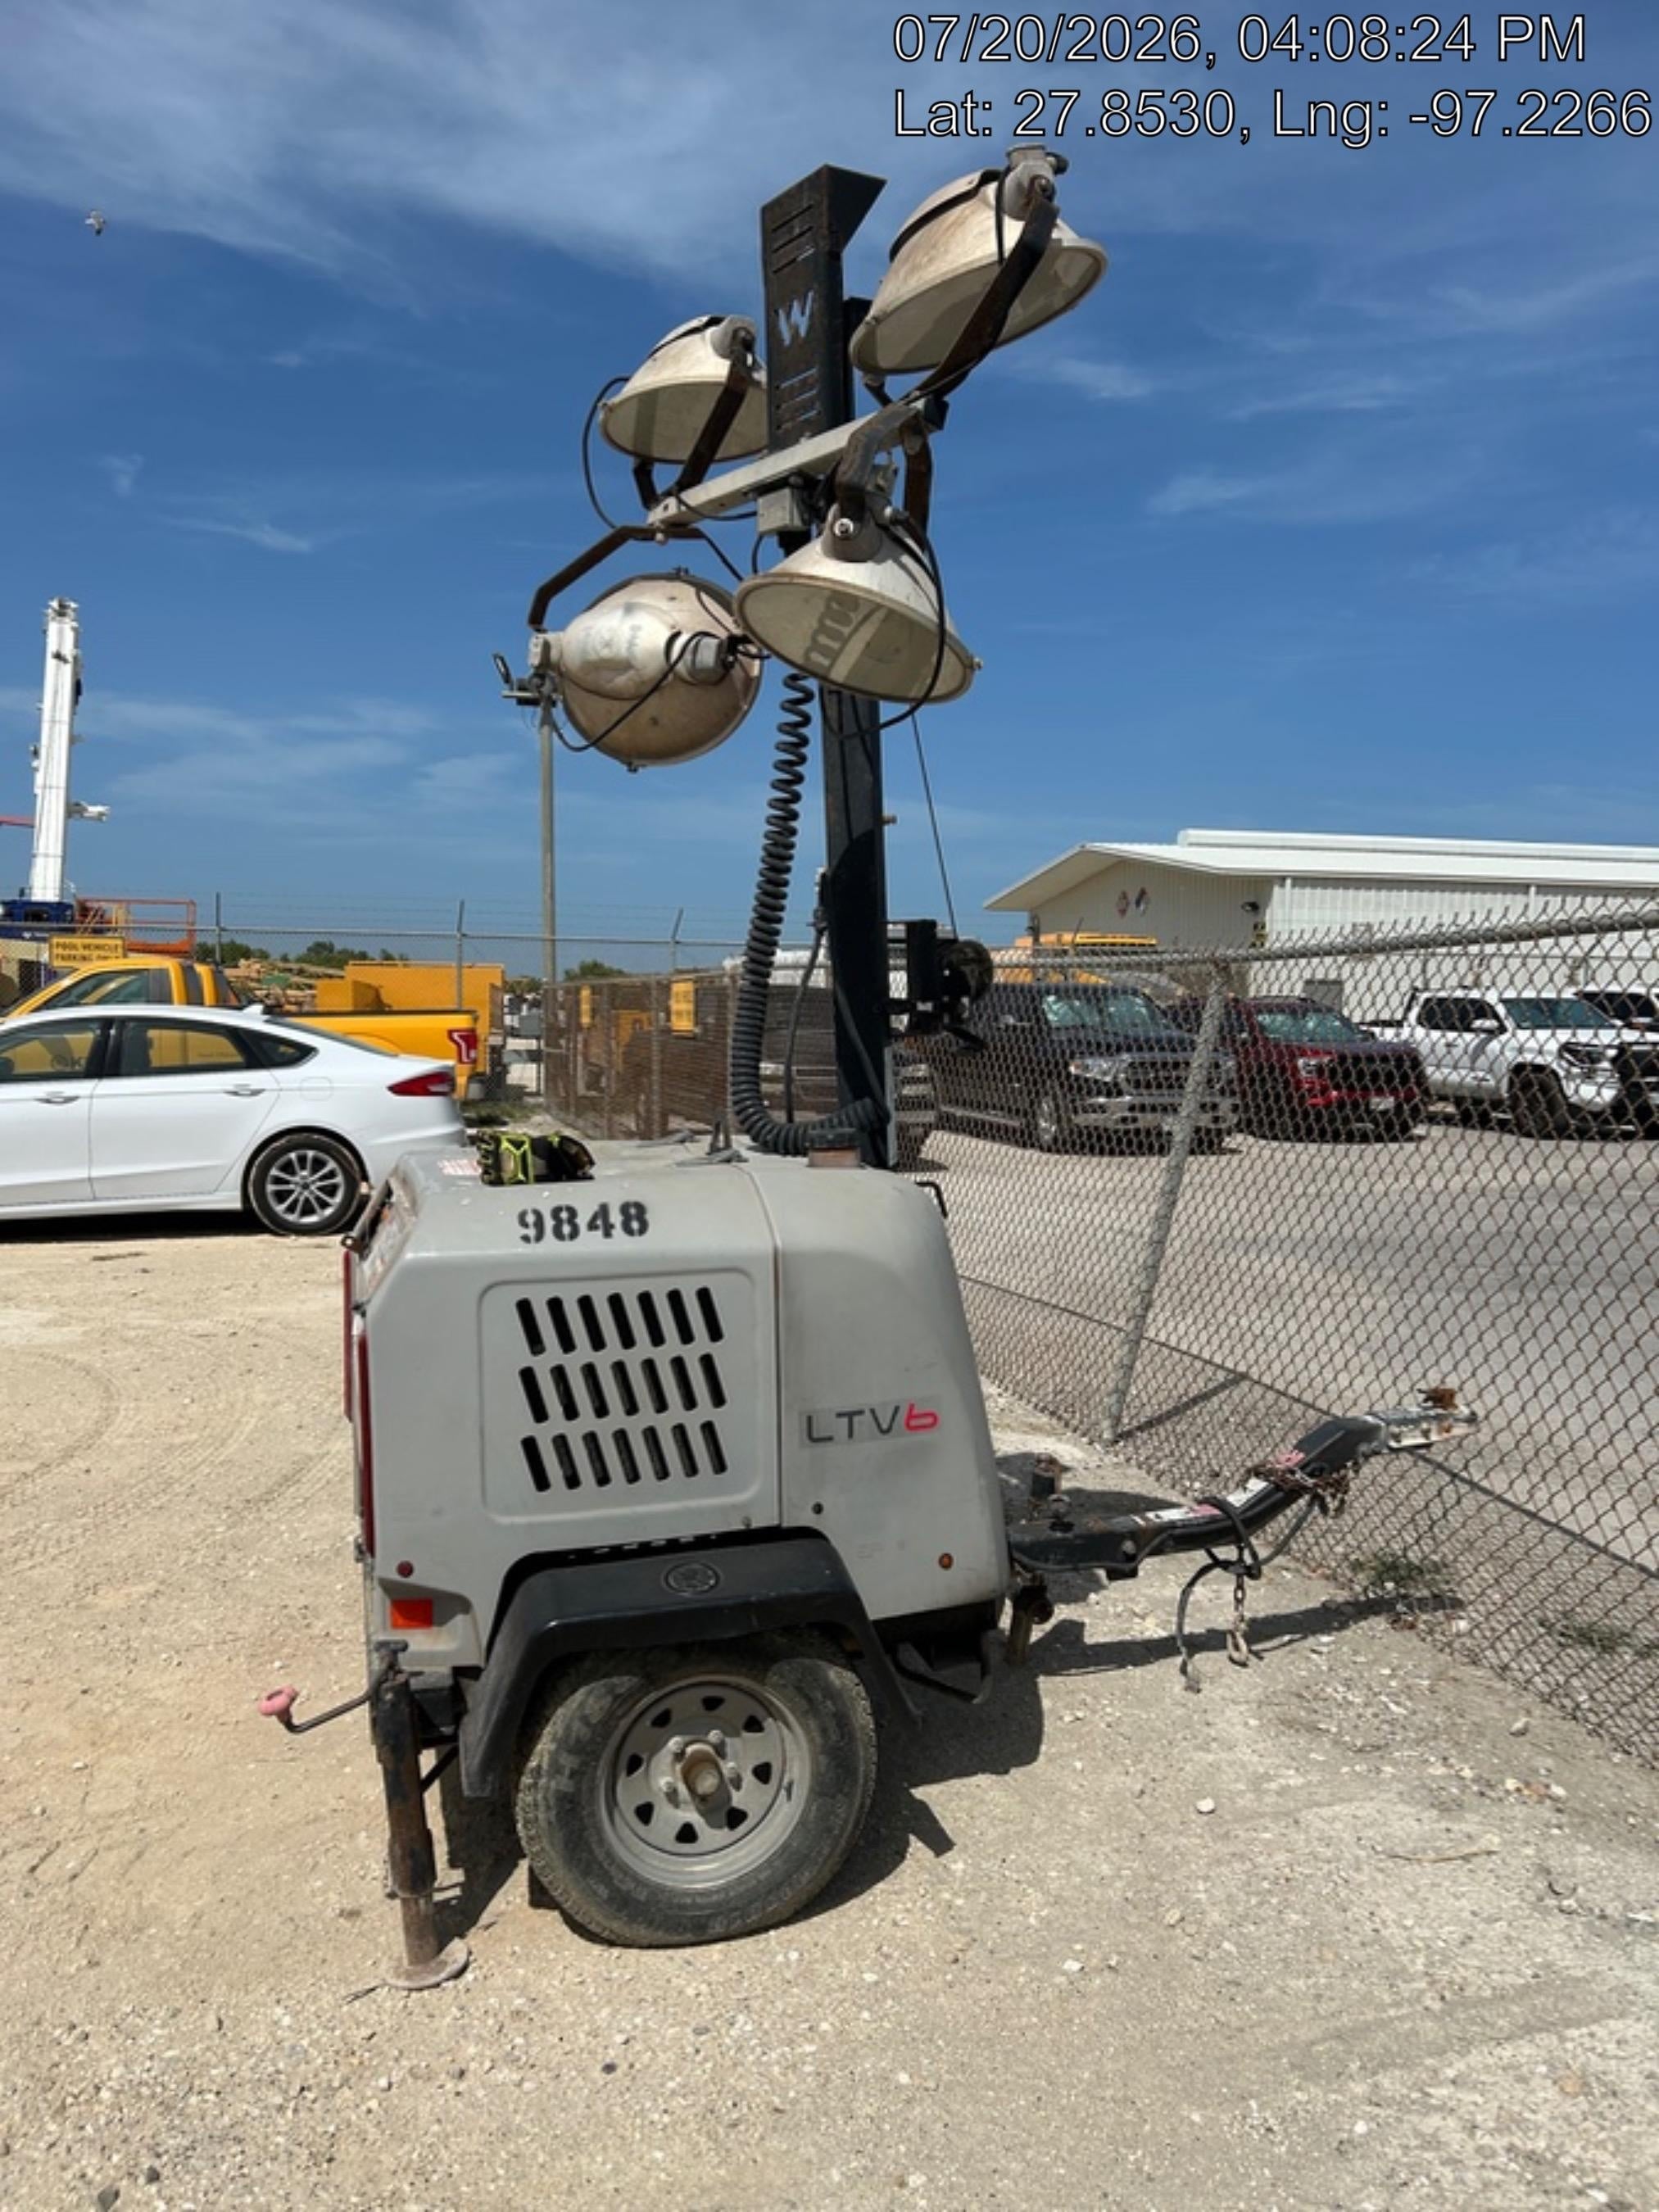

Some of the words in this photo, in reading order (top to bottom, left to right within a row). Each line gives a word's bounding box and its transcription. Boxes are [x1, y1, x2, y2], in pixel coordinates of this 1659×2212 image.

[777, 289, 814, 347] W
[82, 942, 119, 953] VEHICLE
[517, 1201, 650, 1244] 9848
[806, 1403, 939, 1443] LTV6
